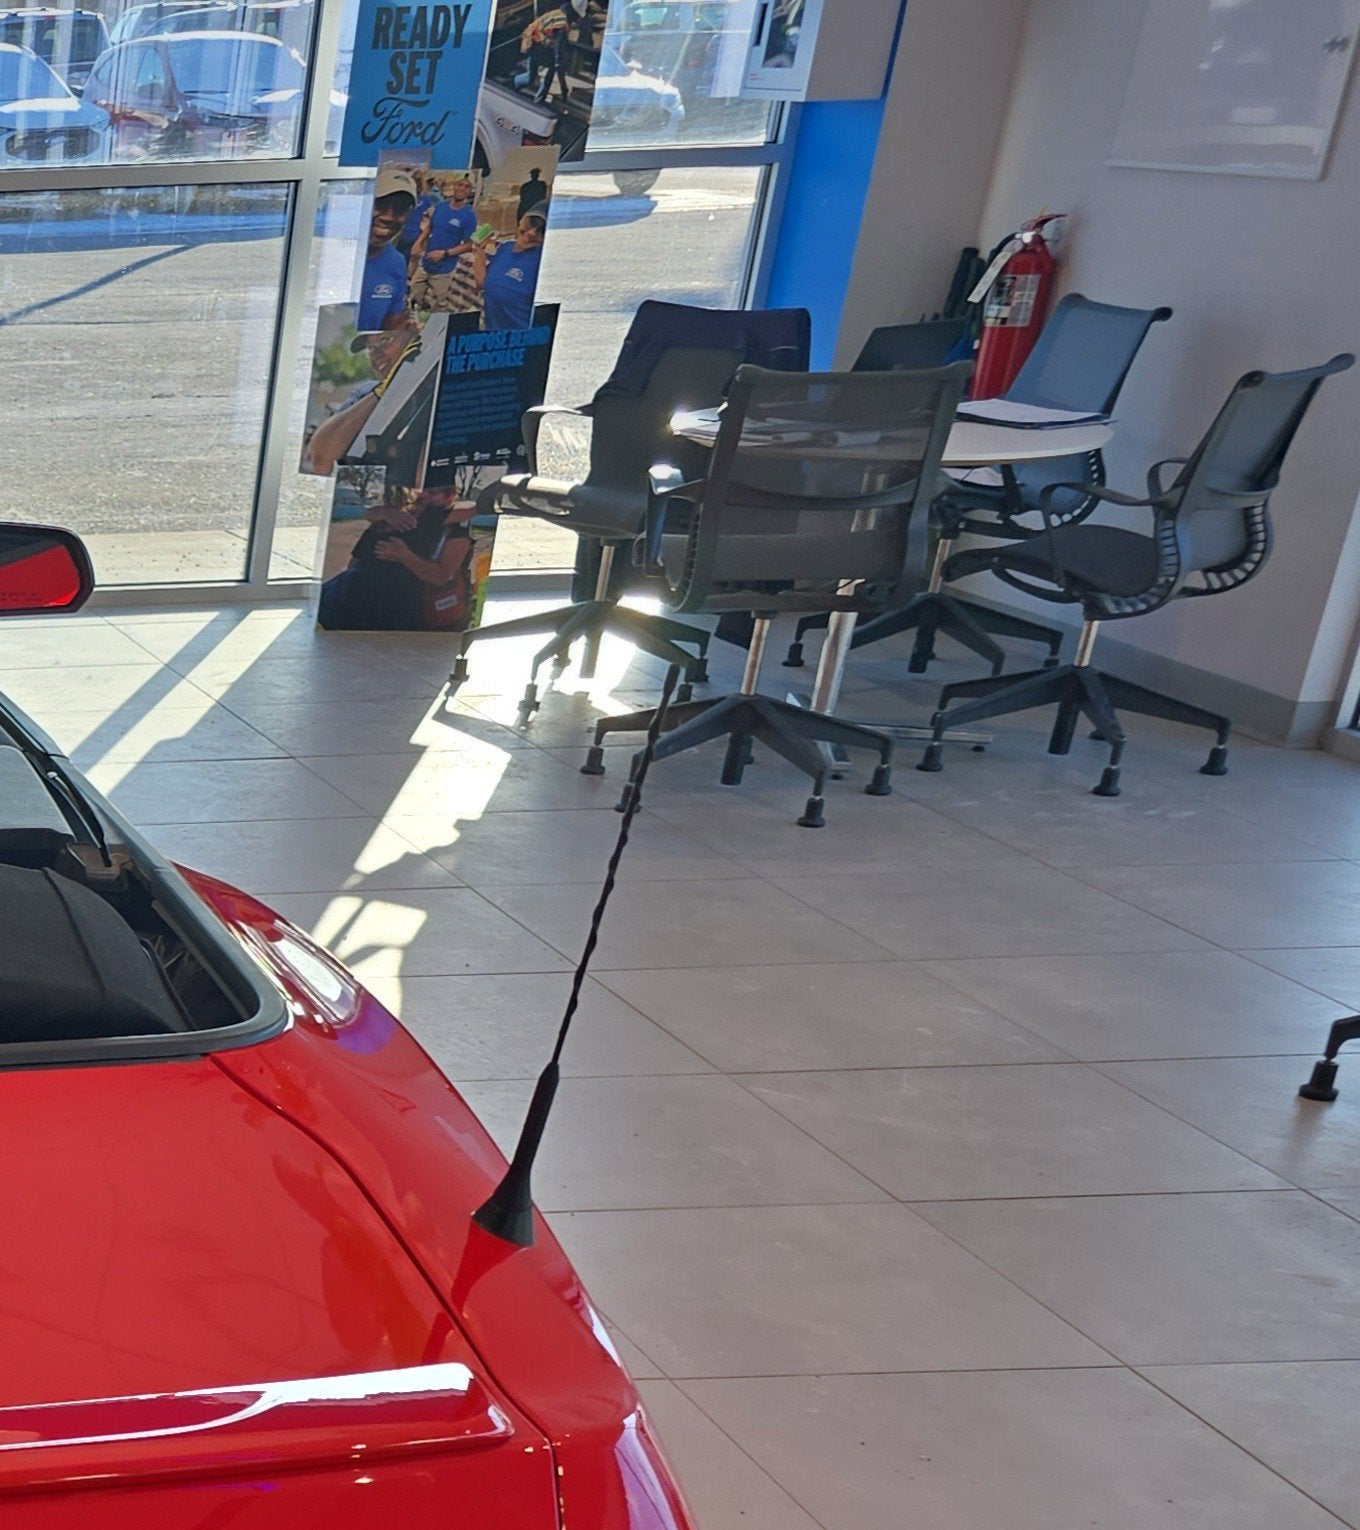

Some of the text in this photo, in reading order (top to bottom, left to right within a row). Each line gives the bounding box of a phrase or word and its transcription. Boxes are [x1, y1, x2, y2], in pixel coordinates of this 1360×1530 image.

[371, 4, 473, 50] READY
[386, 51, 443, 95] SET
[361, 97, 451, 146] Ford
[457, 331, 507, 353] PURPOSE
[446, 355, 467, 374] THE
